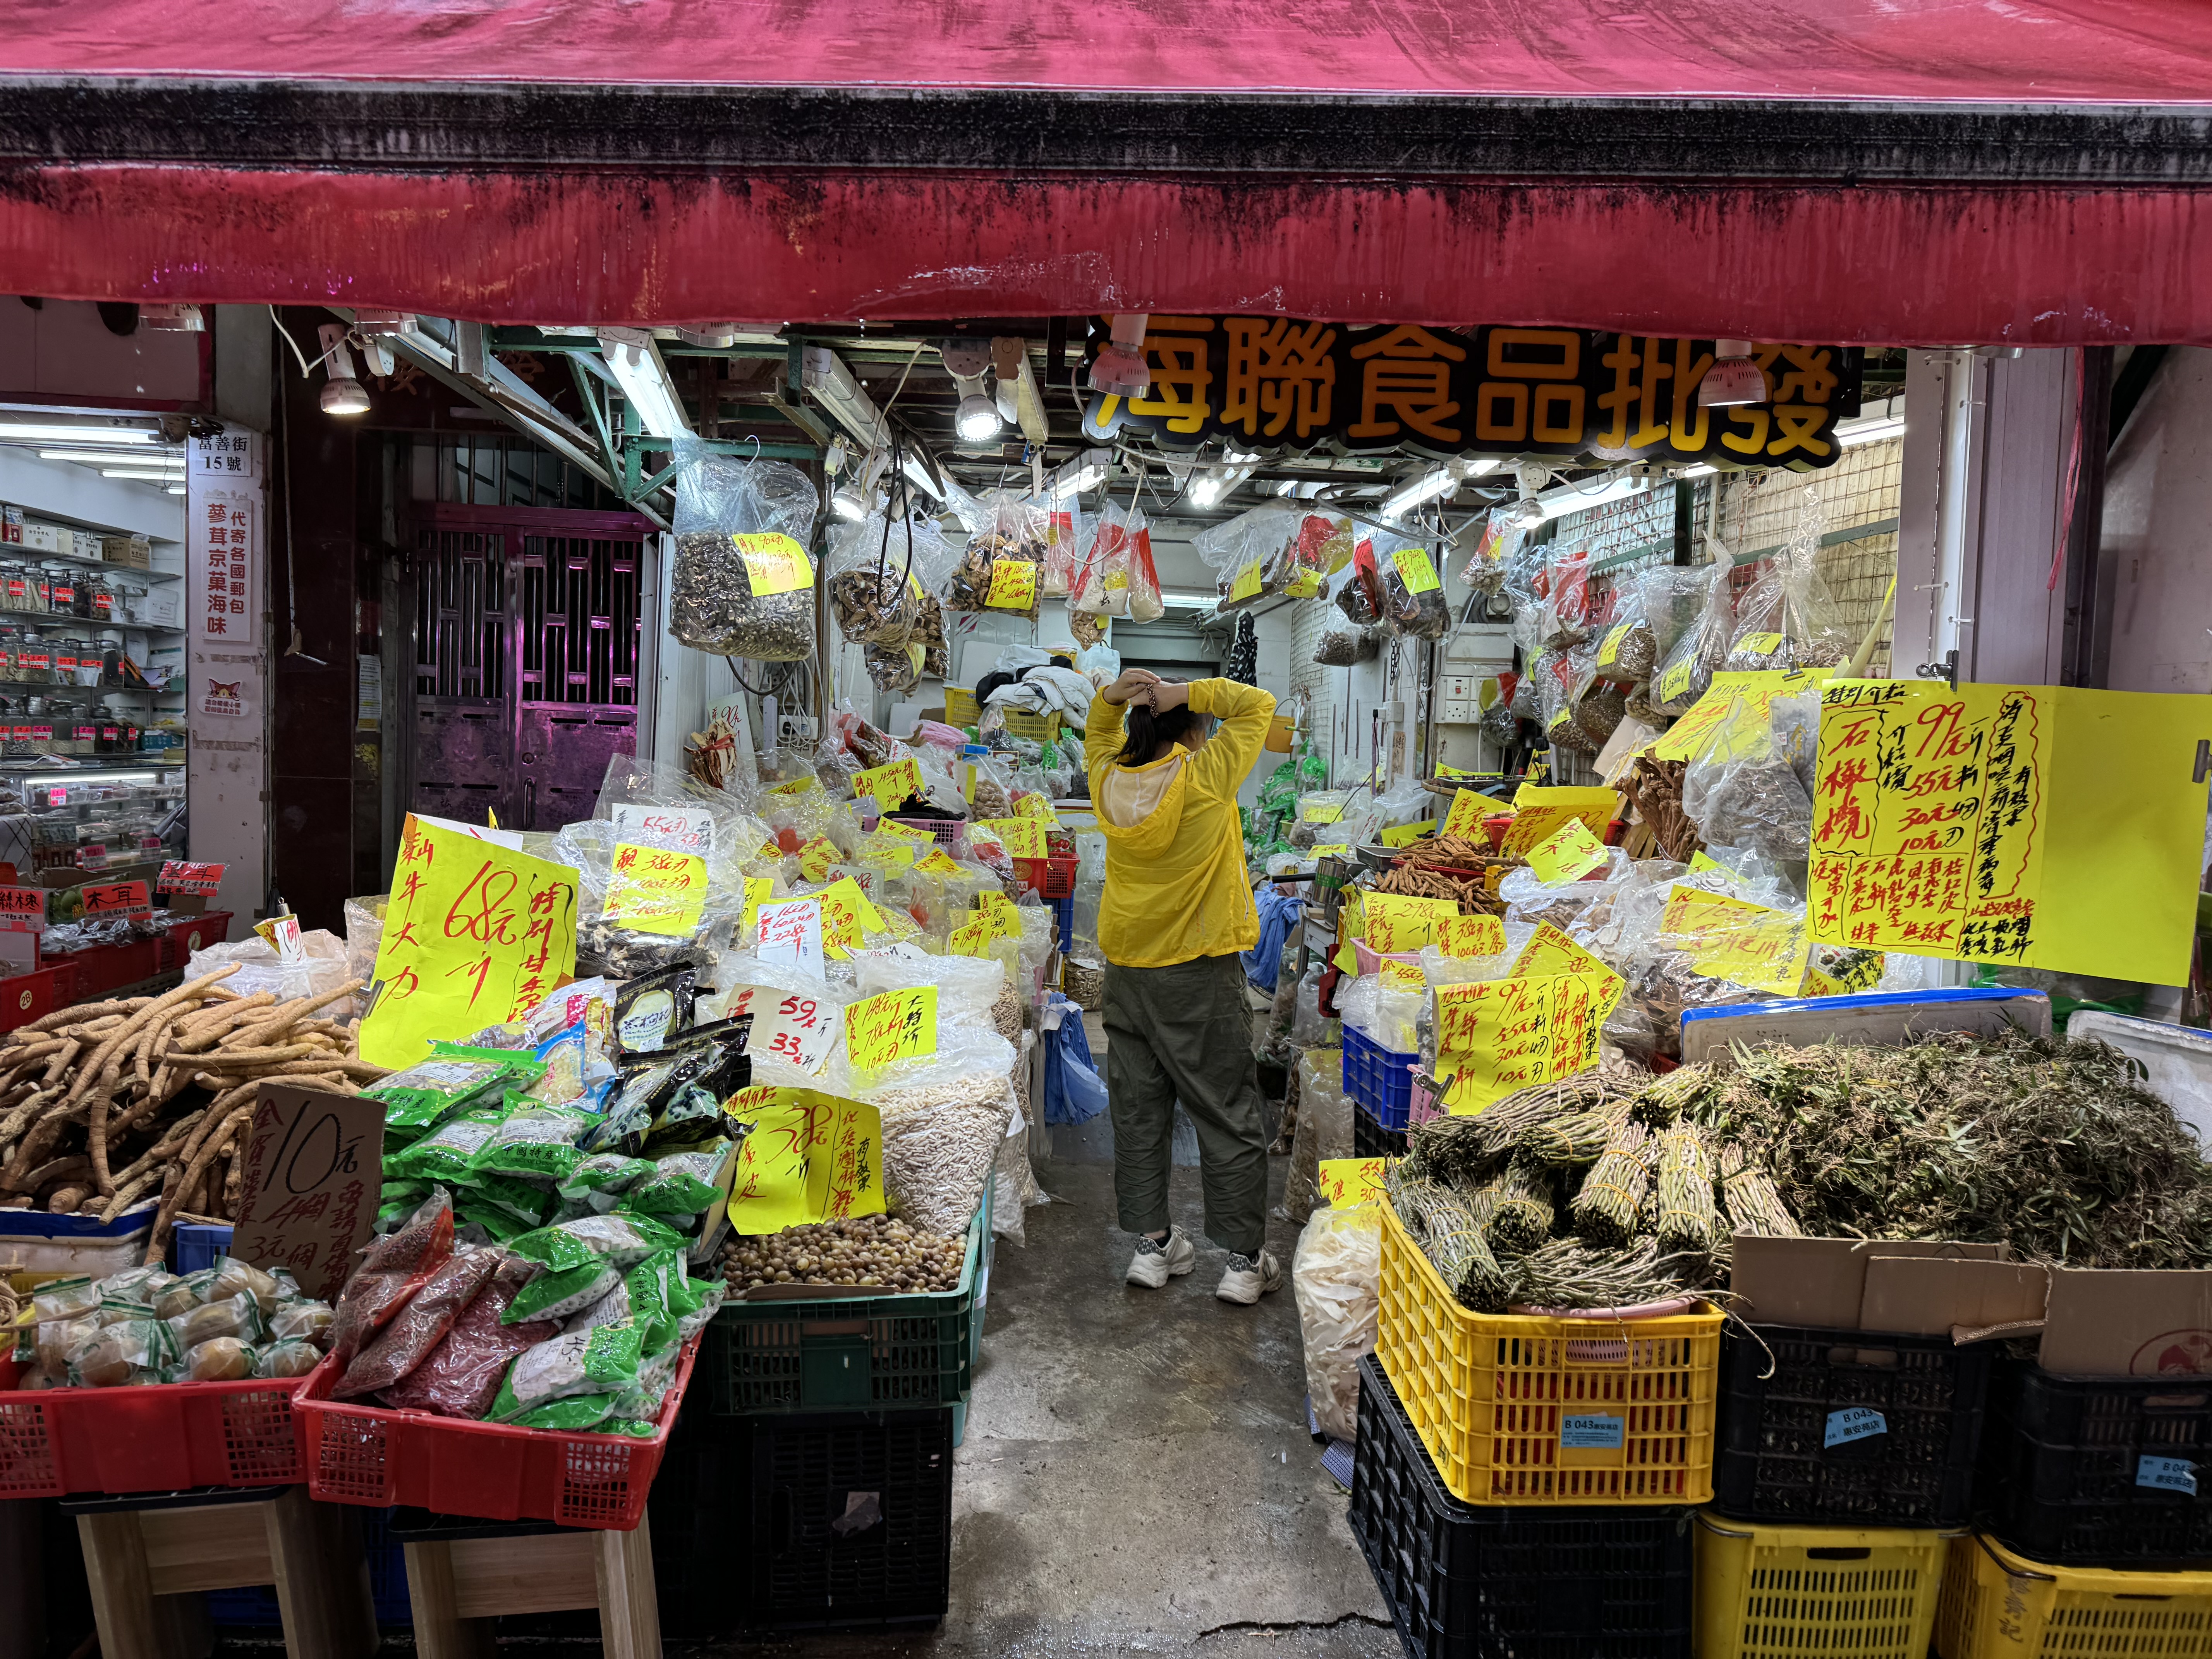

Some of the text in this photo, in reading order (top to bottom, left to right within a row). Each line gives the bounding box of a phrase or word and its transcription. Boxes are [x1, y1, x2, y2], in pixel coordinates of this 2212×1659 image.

[229, 510, 246, 615] 代寄各國郵包
[86, 884, 143, 909] 木耳
[21, 993, 32, 1007] 2B
[1843, 1409, 1873, 1422] B 043
[1565, 1420, 1571, 1428] B
[1575, 1420, 1594, 1429] 043
